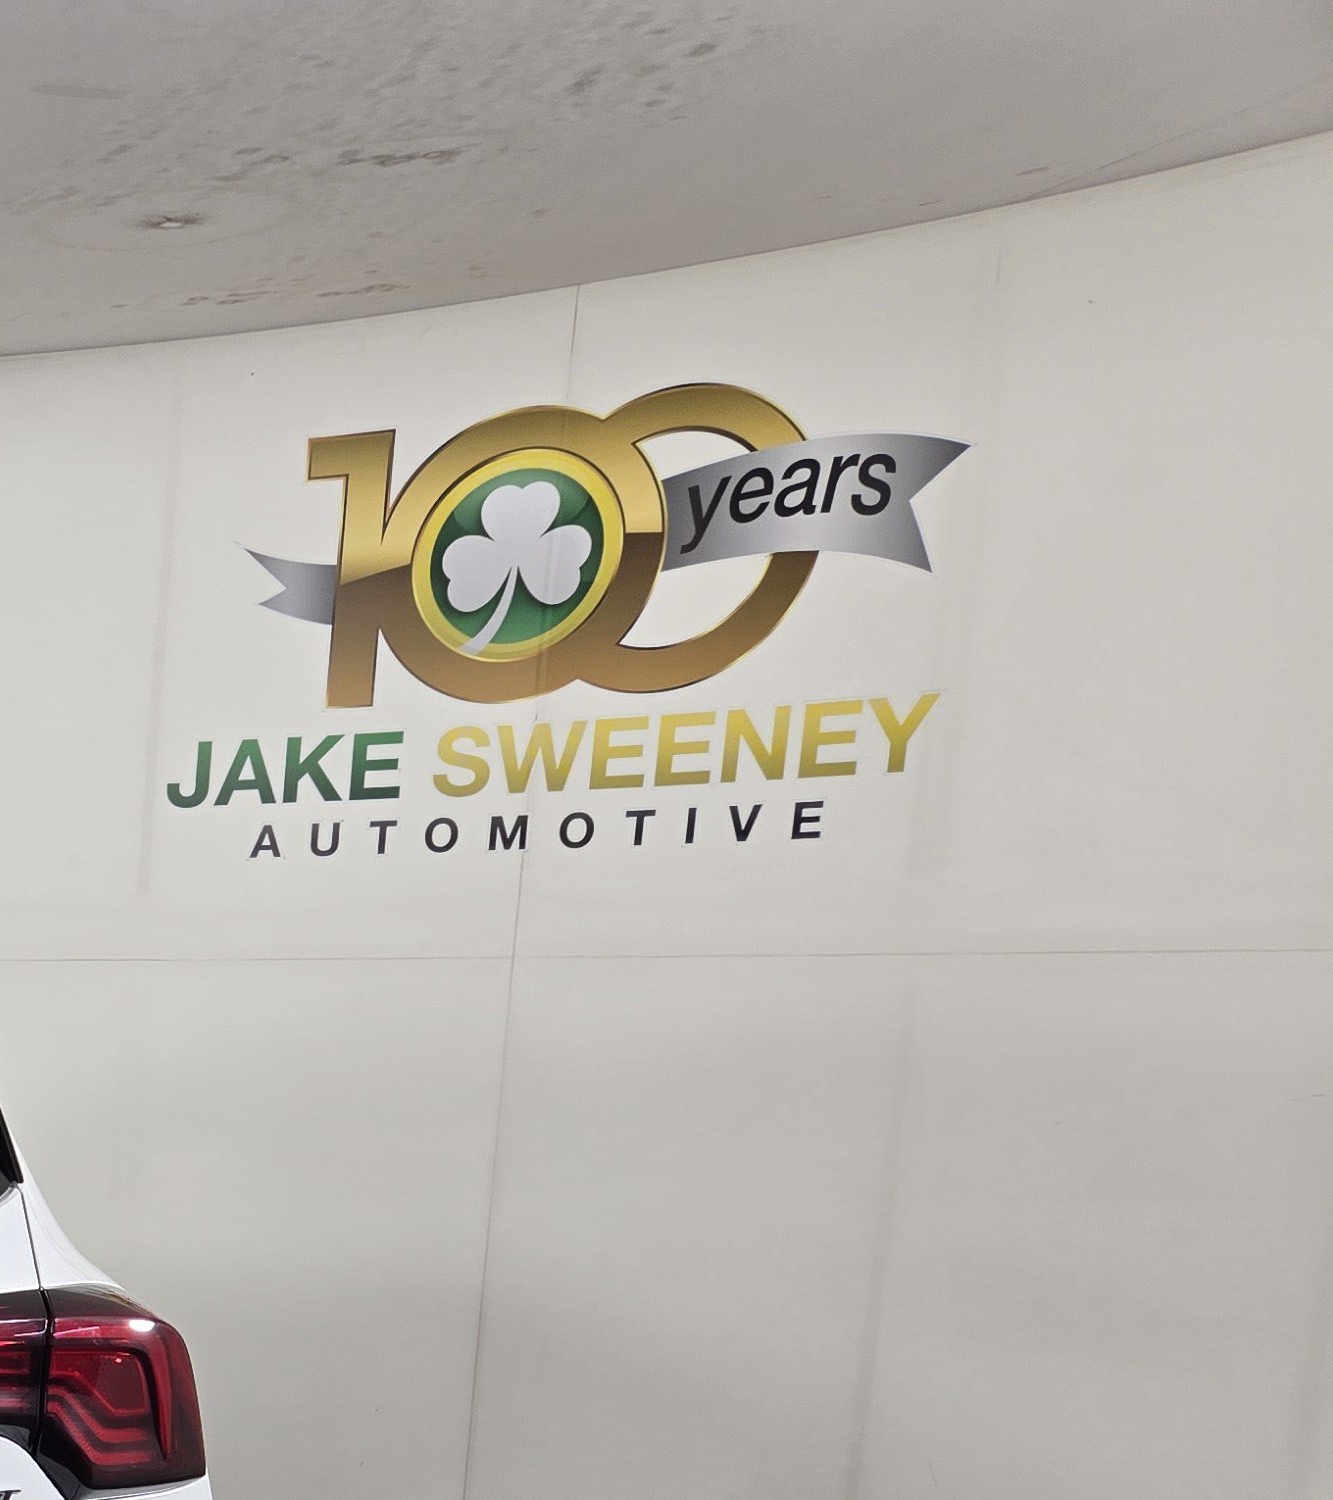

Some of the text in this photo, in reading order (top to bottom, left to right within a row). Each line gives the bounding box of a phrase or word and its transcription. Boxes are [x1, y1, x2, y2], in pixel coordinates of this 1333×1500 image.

[307, 383, 897, 707] 100 years
[167, 693, 940, 808] JAKE SWEENEY
[249, 800, 826, 859] AUTOMOTIVE
